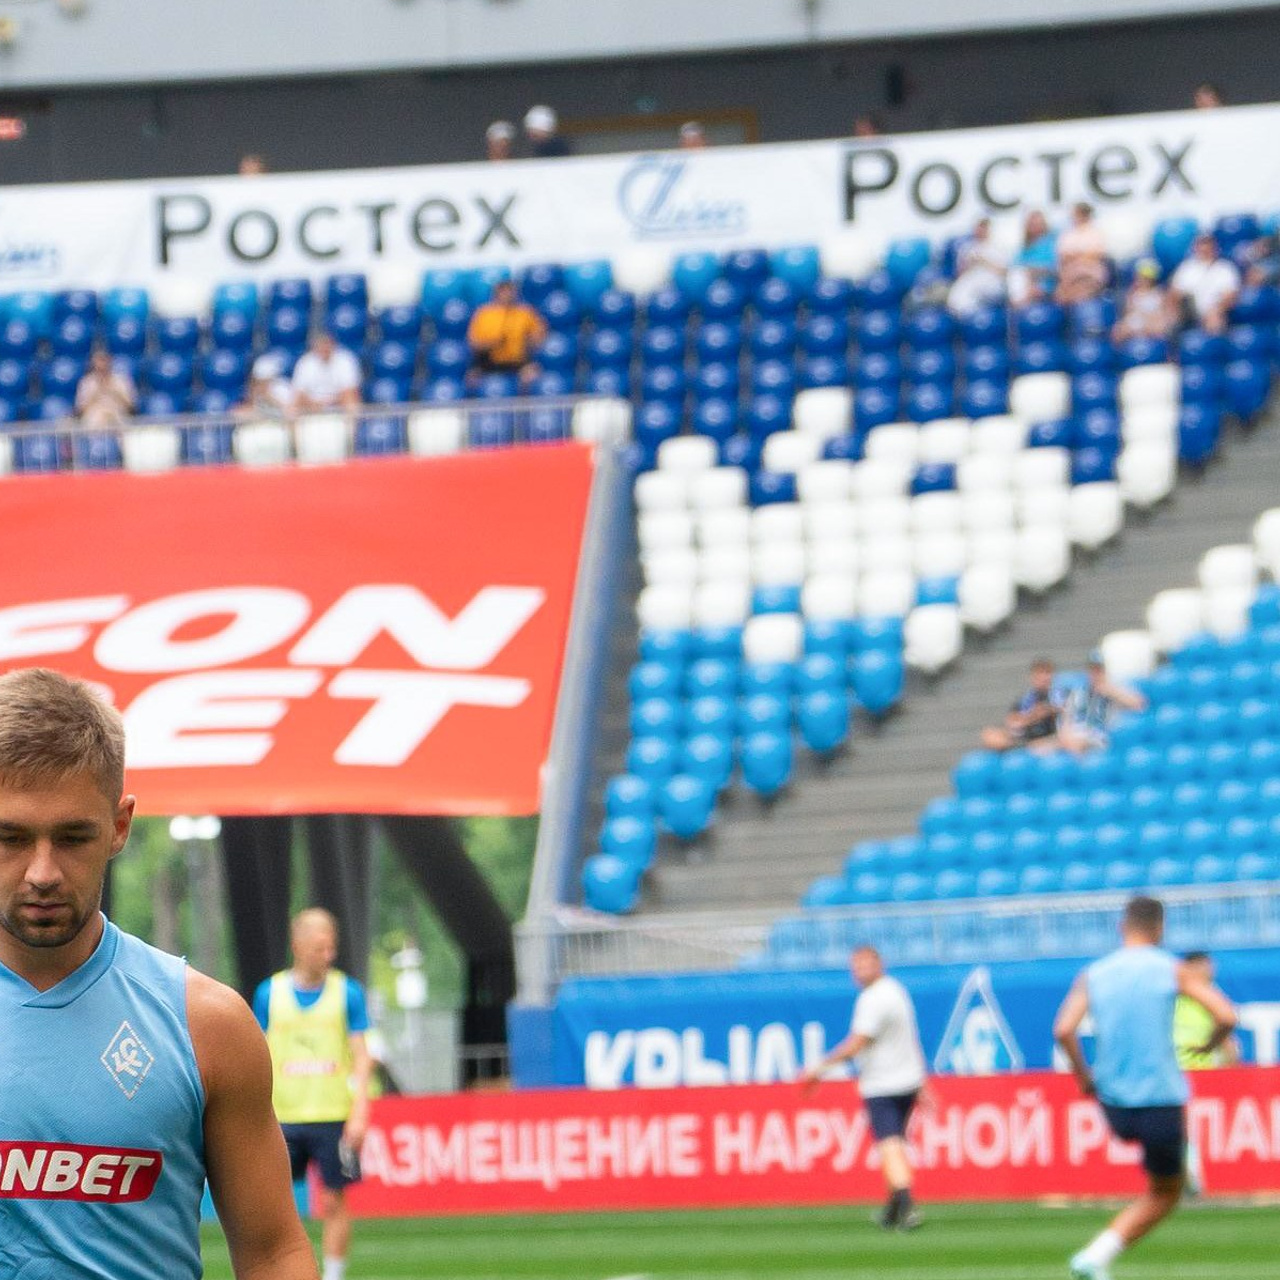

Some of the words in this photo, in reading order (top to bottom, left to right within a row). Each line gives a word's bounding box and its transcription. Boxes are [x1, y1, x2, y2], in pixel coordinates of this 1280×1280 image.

[842, 135, 1197, 222] Ростех
[153, 191, 521, 266] Ростех
[360, 1111, 702, 1191] АЗМЕЩЕНИЕ
